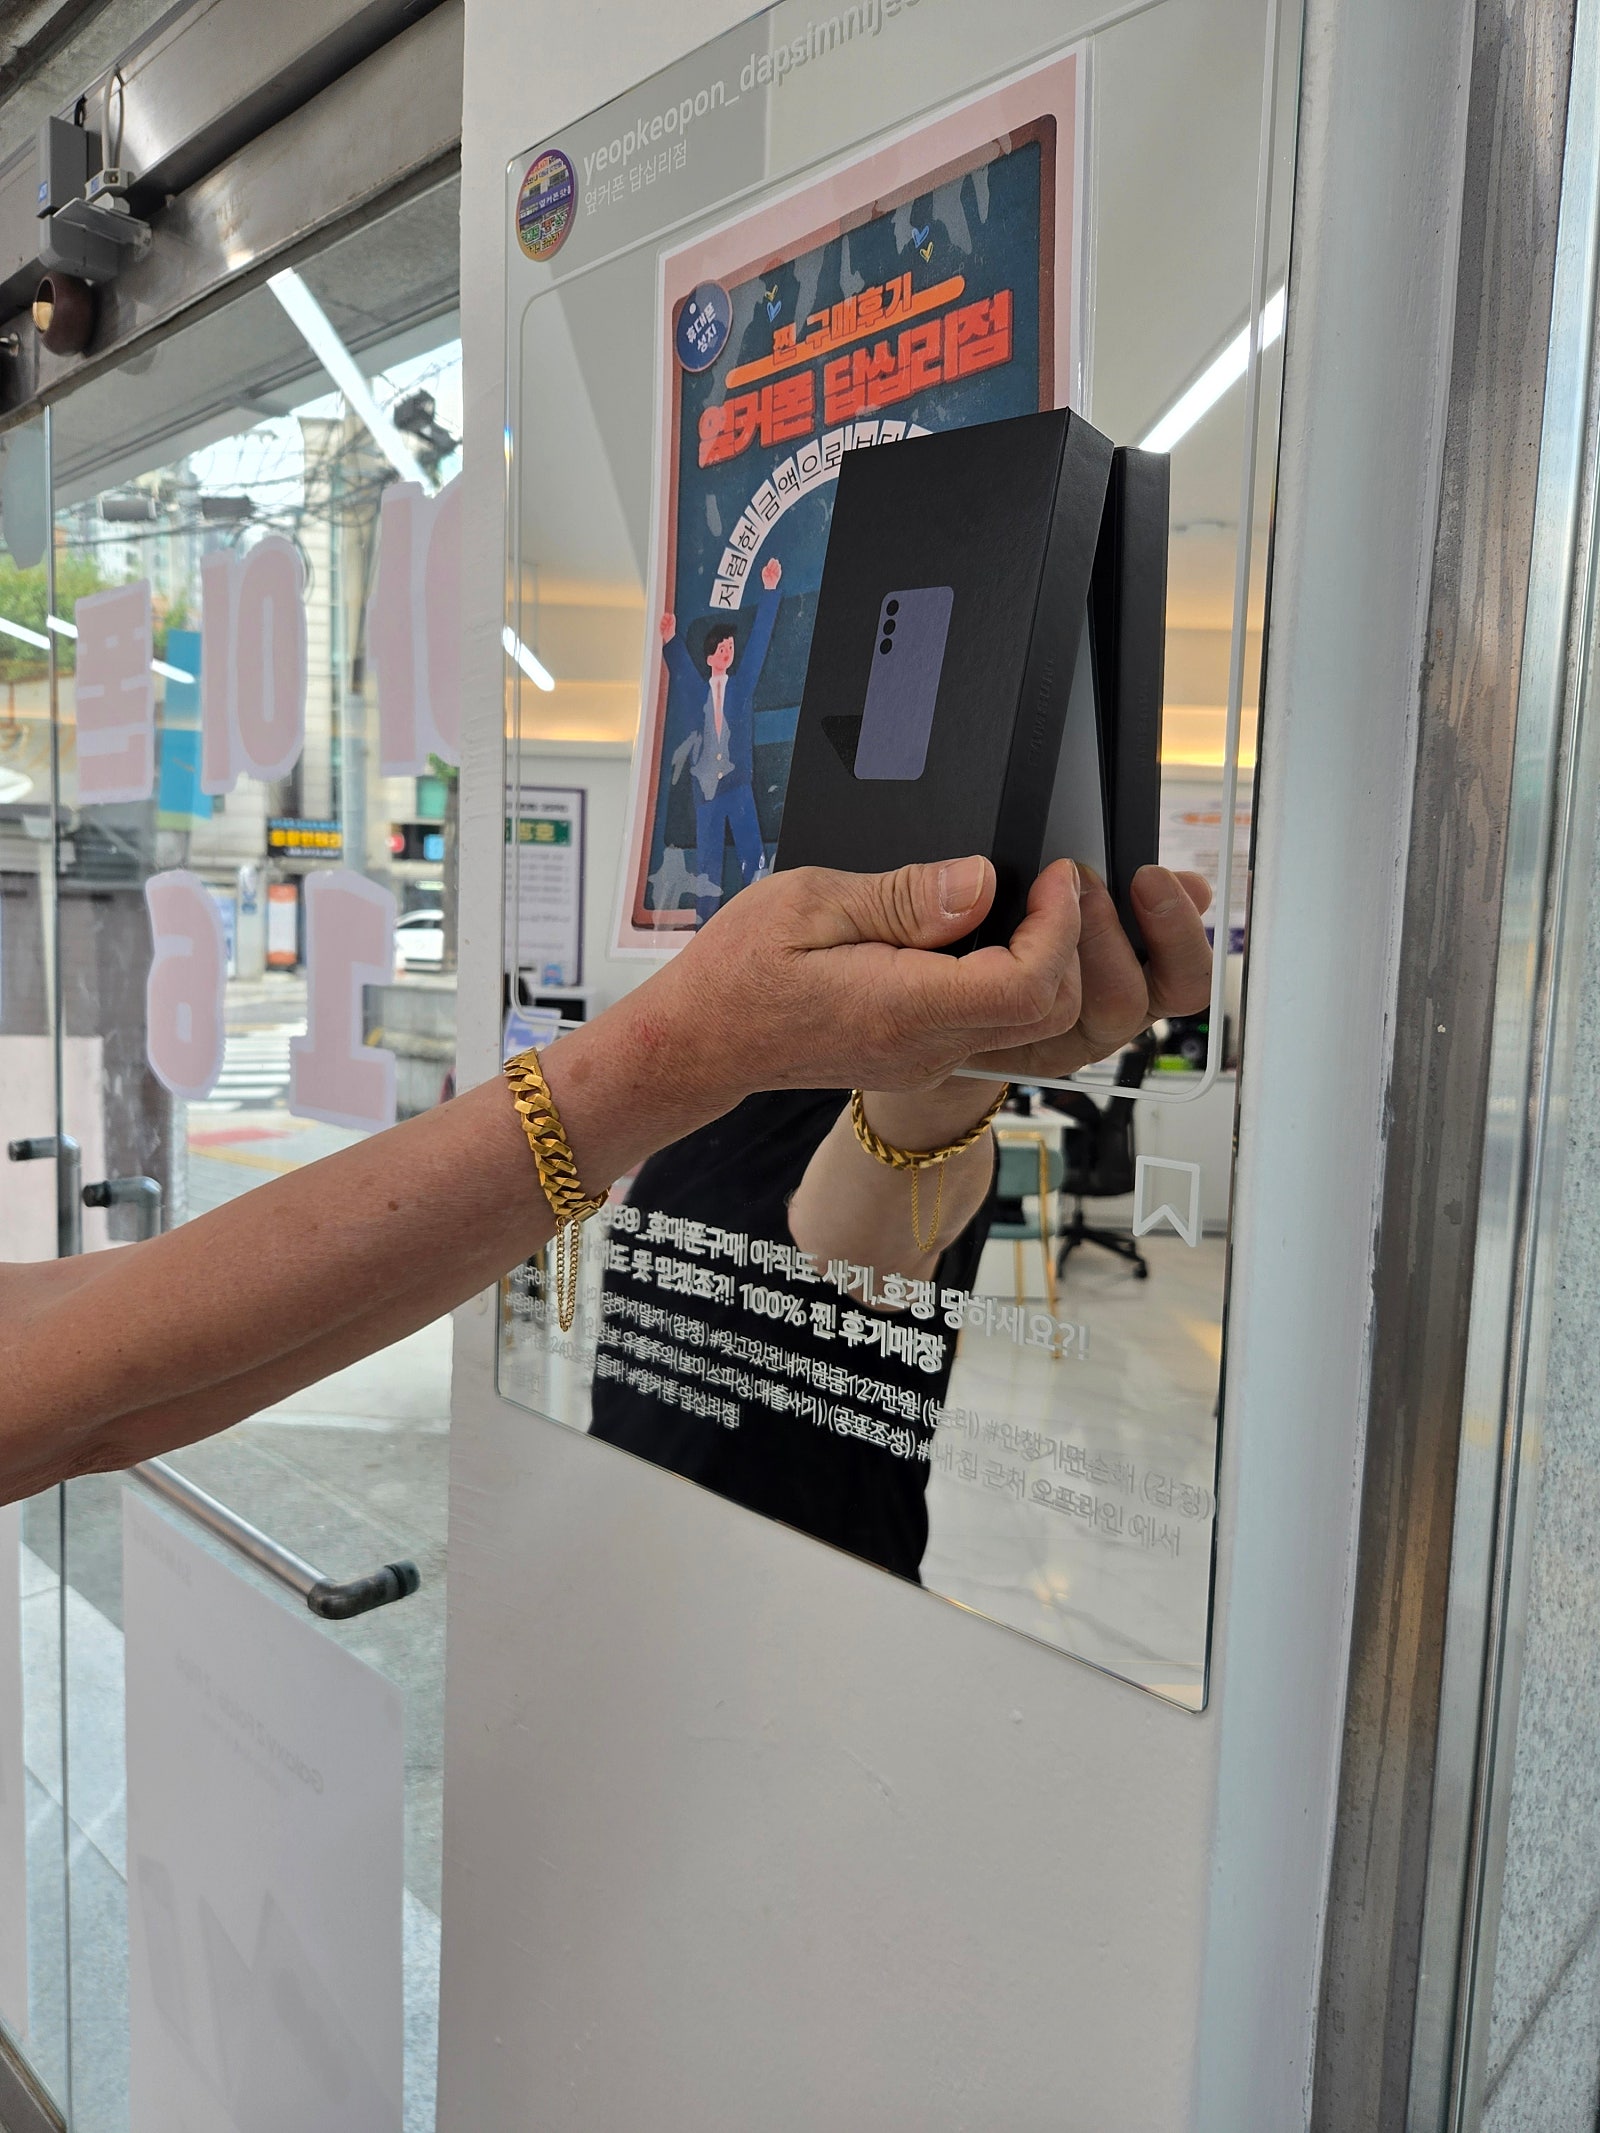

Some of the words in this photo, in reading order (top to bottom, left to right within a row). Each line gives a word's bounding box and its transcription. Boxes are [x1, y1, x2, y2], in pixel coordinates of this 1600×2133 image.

[584, 181, 625, 216] 옆커폰
[629, 140, 688, 193] 답십리점
[686, 302, 716, 343] 휴대폰
[697, 323, 717, 352] 성지
[773, 324, 797, 366] 찐
[806, 272, 913, 349] 구매후기
[698, 369, 815, 468] 옆커폰
[823, 289, 1014, 425] 답십리점
[718, 525, 758, 607] 저렴한
[755, 441, 842, 521] 금액으로
[631, 1248, 655, 1283] 못
[740, 1281, 806, 1327] 100%
[839, 1309, 947, 1374] 후기매장
[750, 1238, 821, 1284] 아직도
[940, 1287, 1090, 1361] 당하세요?!
[983, 1459, 1027, 1500] 근처
